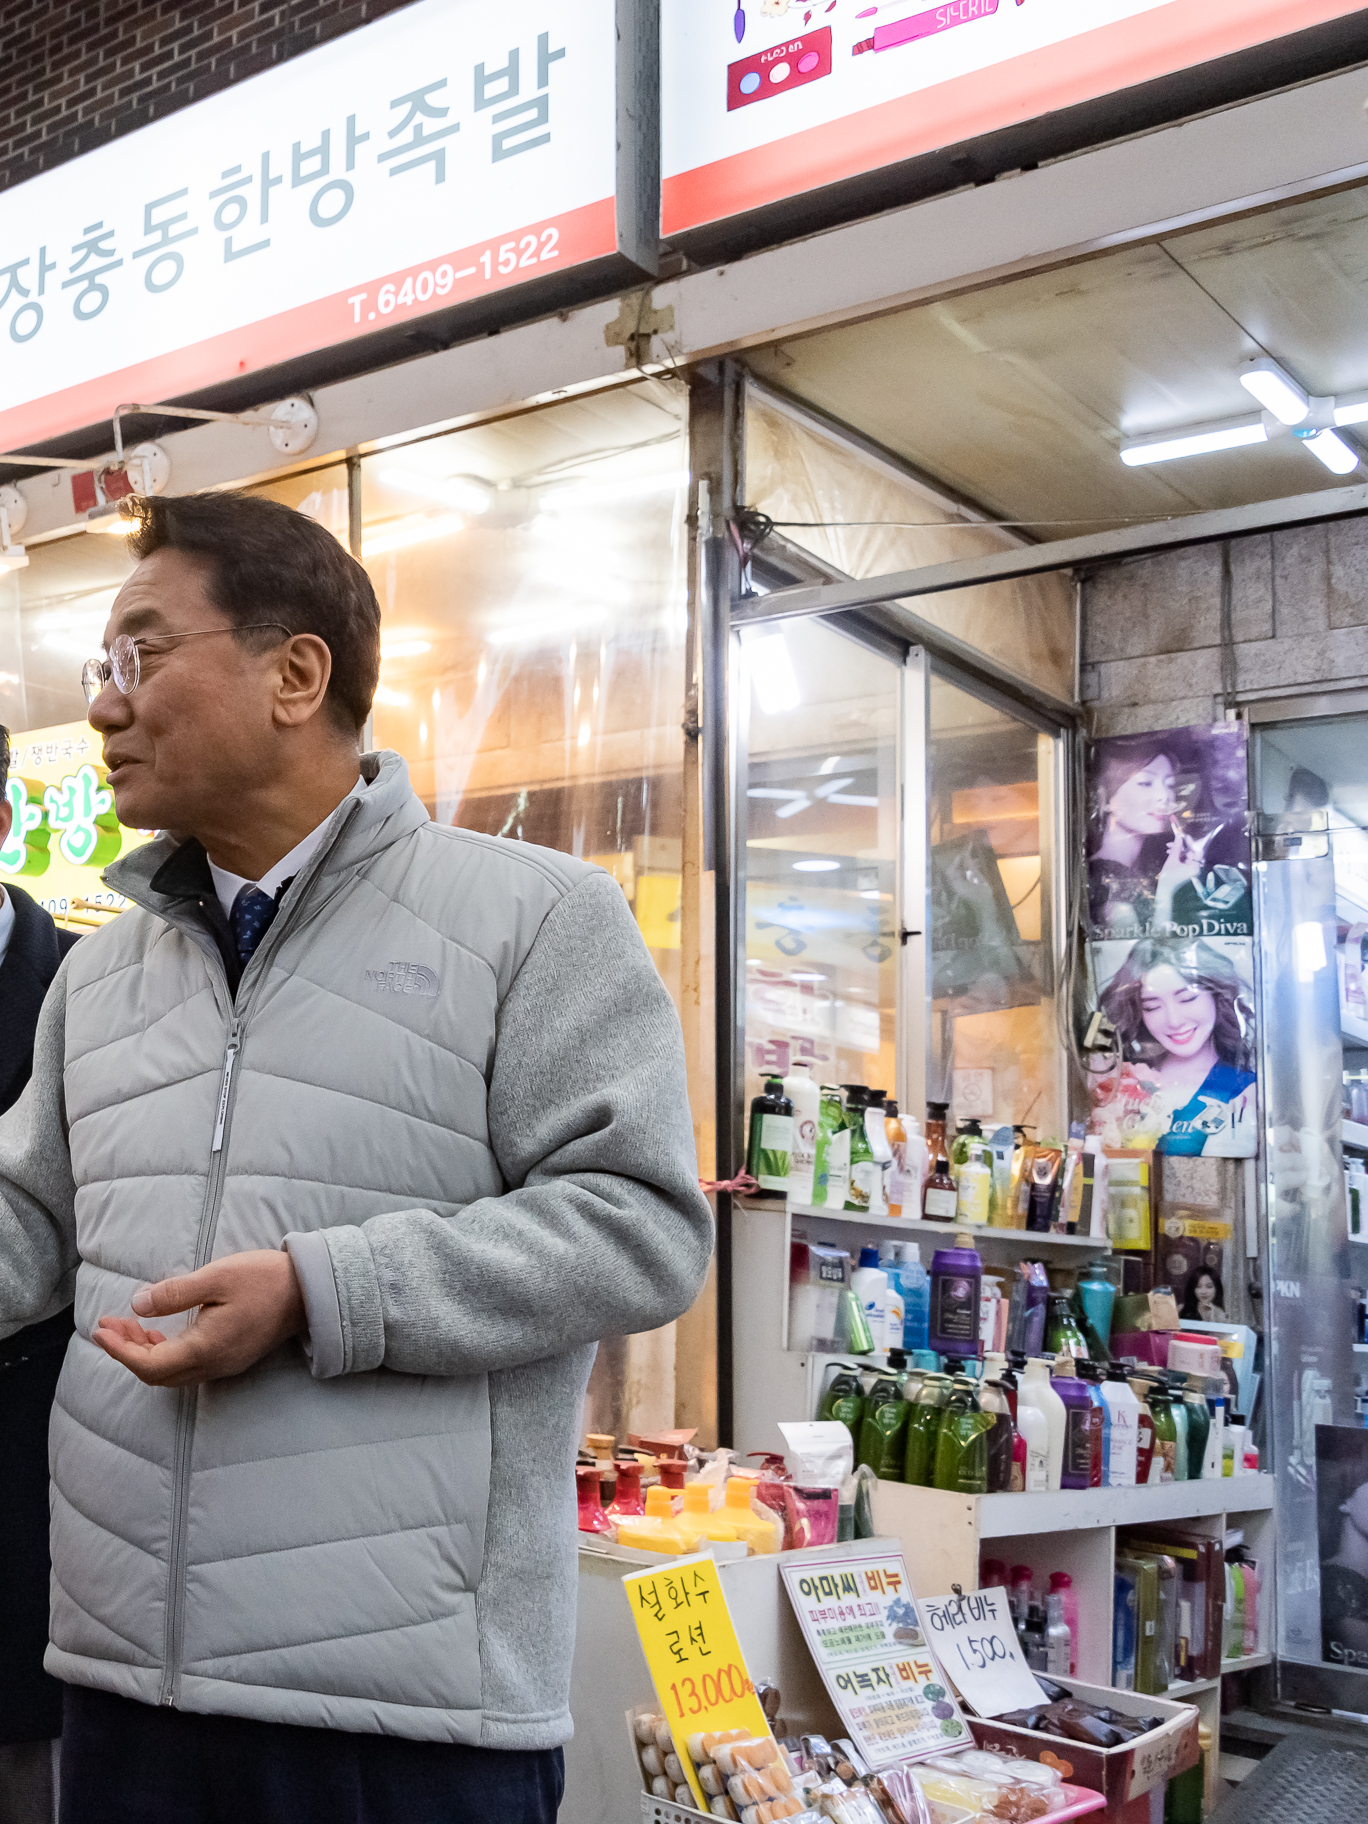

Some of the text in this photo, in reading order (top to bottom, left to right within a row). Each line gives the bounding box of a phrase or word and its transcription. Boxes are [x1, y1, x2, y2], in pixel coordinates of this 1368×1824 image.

[347, 227, 560, 325] T.6409-1522
[1092, 918, 1249, 939] Sparkle Pop Diva
[389, 960, 419, 974] THE
[376, 981, 414, 994] FACE
[638, 1570, 710, 1622] 설화수
[798, 1571, 861, 1604] 아마씨
[864, 1568, 903, 1596] 비누
[665, 1621, 712, 1664] 로션
[835, 1665, 894, 1695] 어녹자
[895, 1659, 934, 1685] 비누
